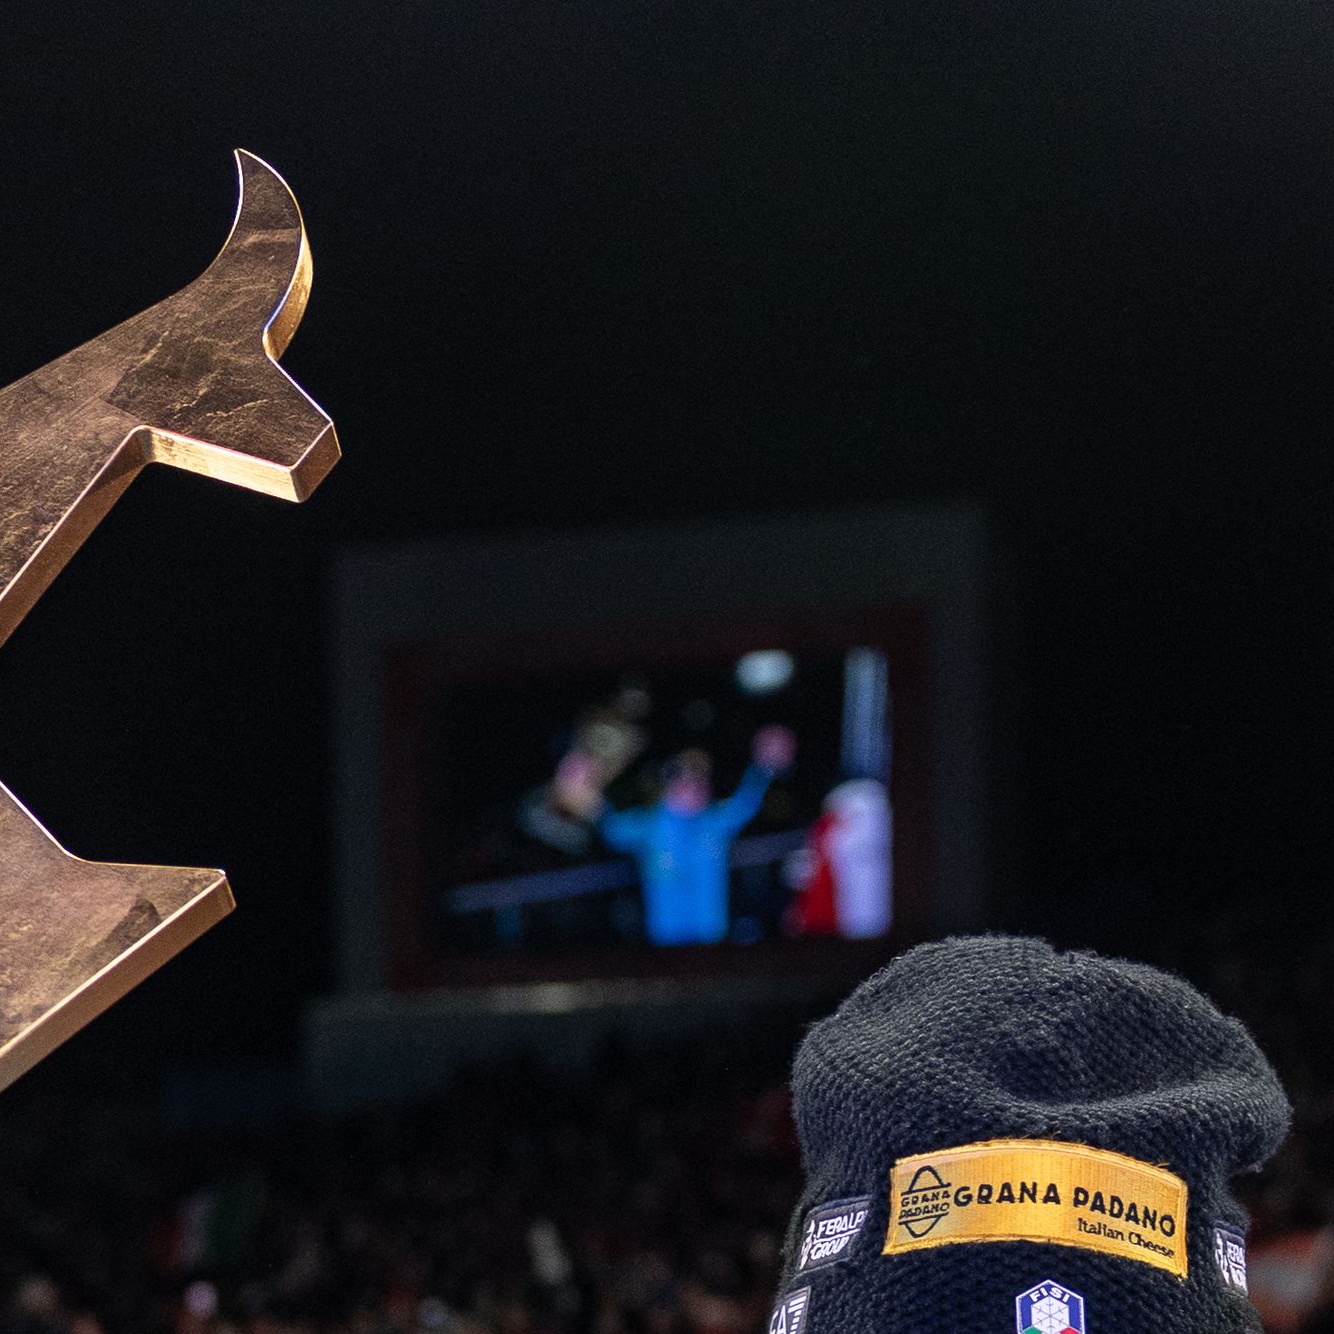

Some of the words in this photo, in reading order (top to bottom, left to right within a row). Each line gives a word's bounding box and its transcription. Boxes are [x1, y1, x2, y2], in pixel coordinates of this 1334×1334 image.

[901, 1190, 951, 1207] GRANA
[953, 1182, 1061, 1207] GRANA
[1072, 1186, 1176, 1238] PADANO
[1078, 1218, 1124, 1242] Italian
[1127, 1231, 1175, 1259] Cheese
[1029, 1287, 1070, 1303] FISI
